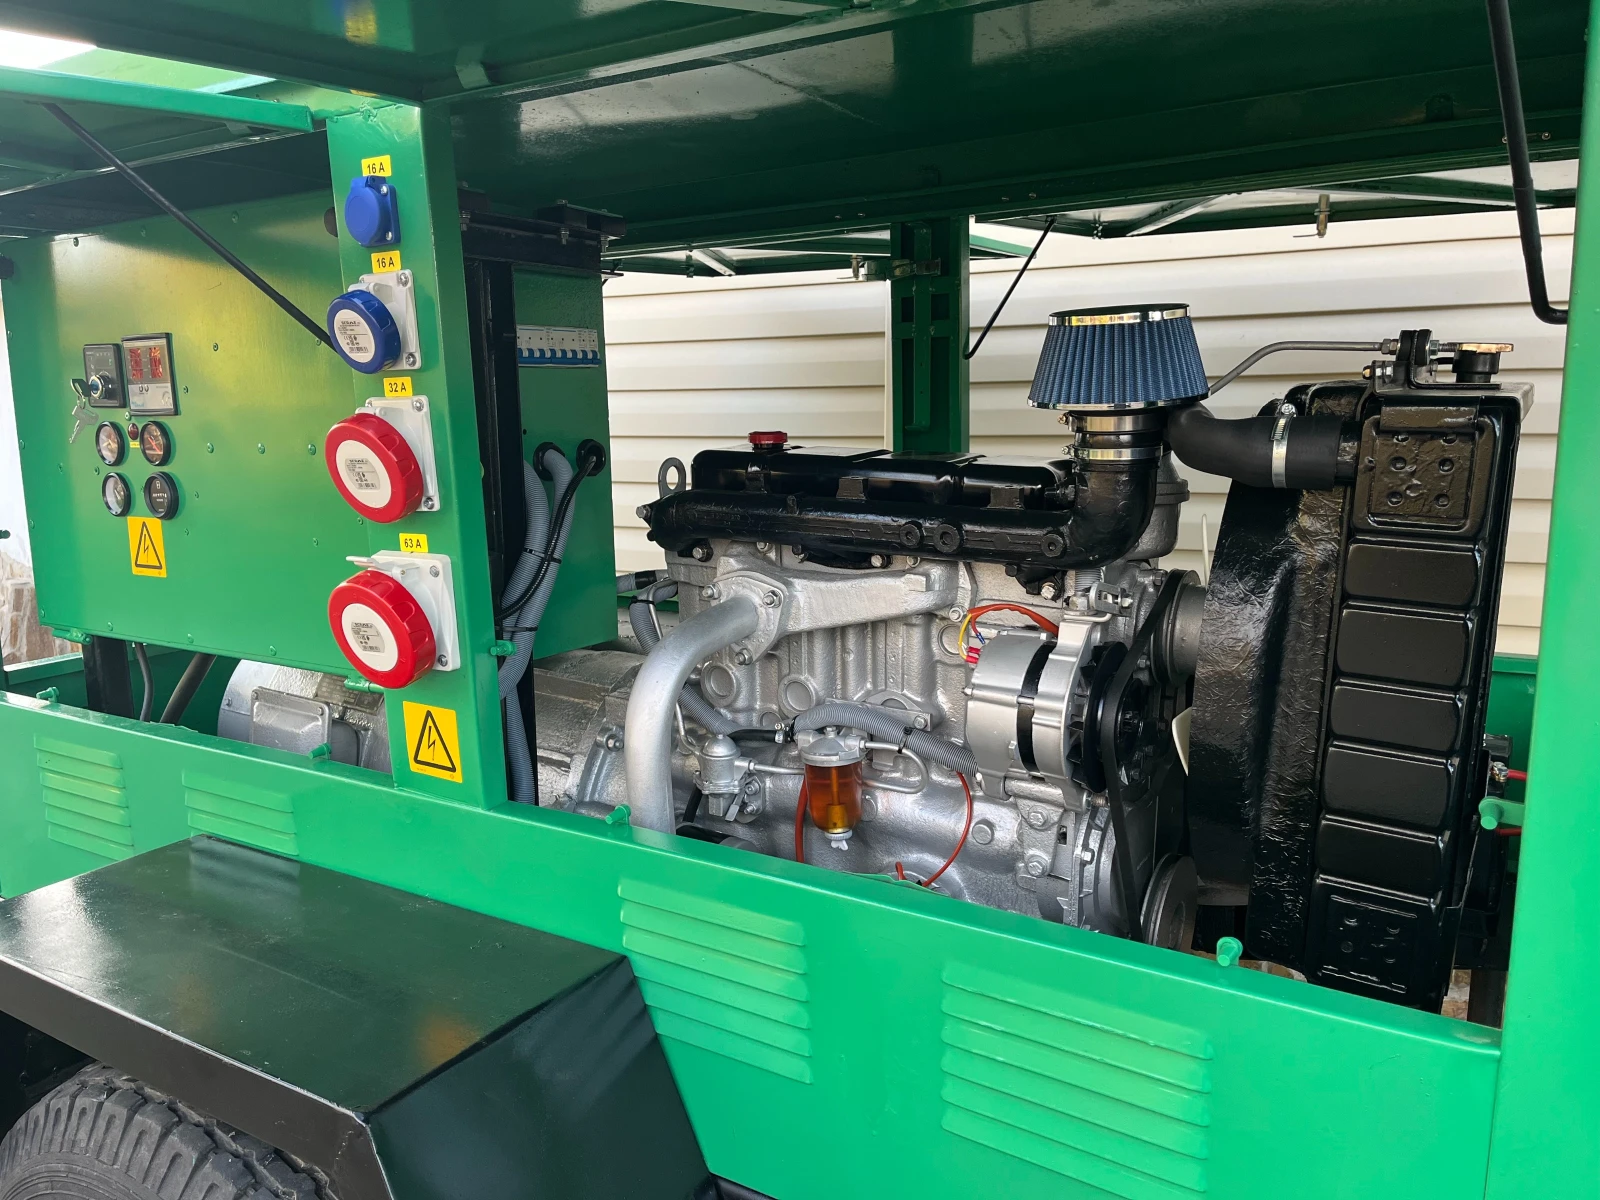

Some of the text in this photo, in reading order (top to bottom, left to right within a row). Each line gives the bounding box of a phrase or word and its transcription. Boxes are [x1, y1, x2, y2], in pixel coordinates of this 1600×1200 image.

[367, 162, 385, 174] 16 A
[377, 257, 395, 268] 16 A
[389, 382, 407, 393] 32 A
[404, 538, 422, 548] 63 A
